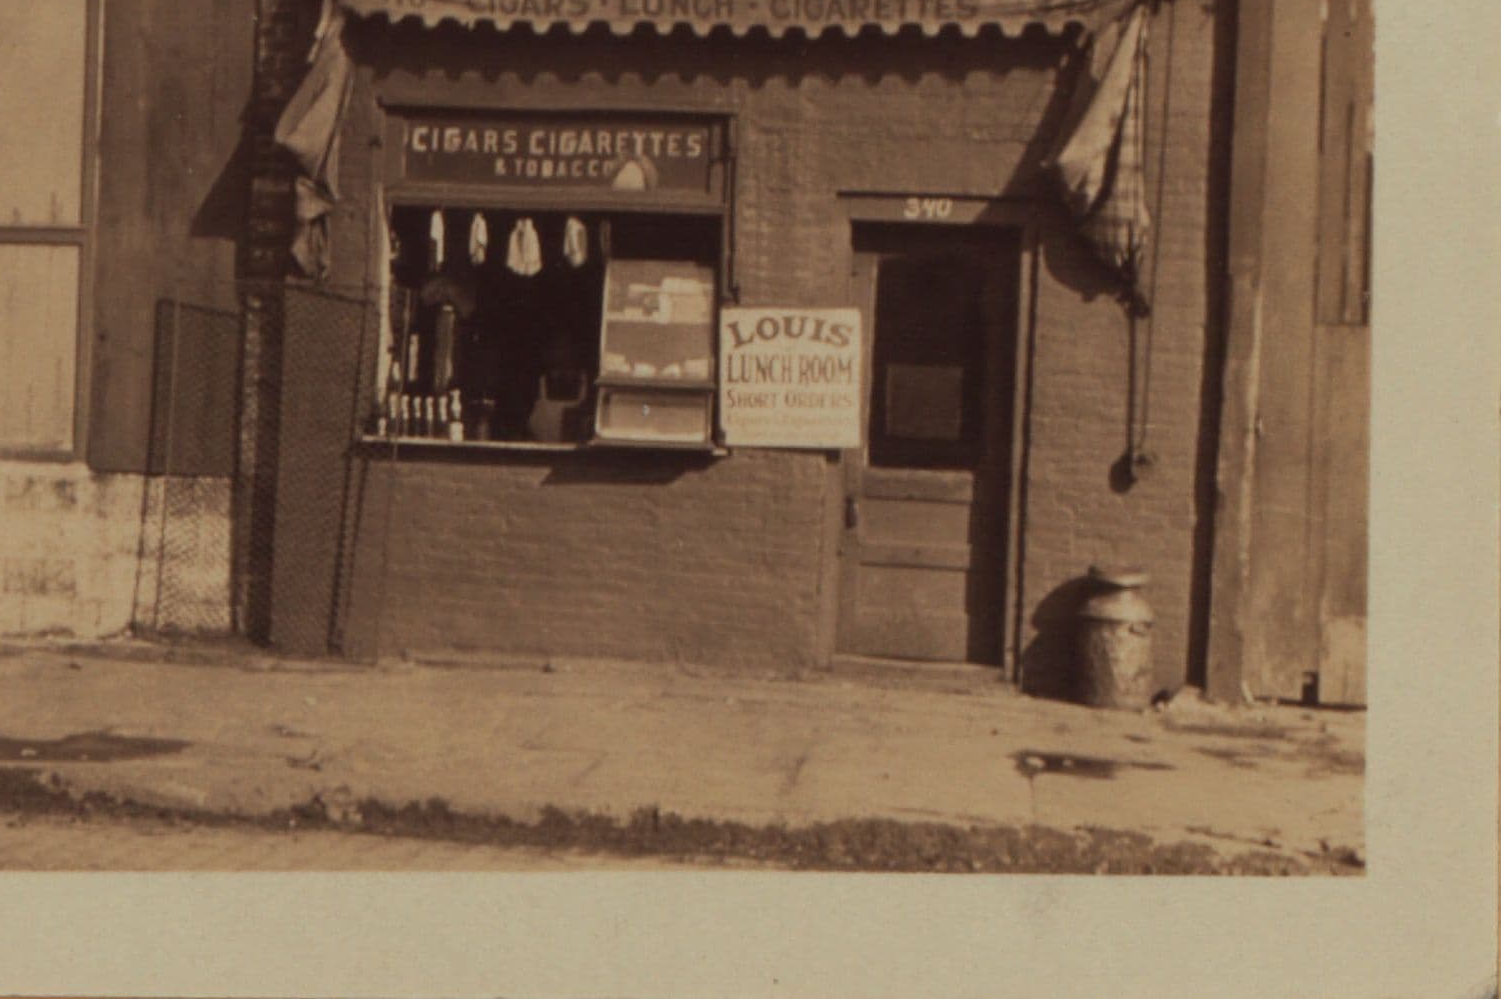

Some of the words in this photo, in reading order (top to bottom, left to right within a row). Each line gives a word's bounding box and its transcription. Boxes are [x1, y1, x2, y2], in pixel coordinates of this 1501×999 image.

[410, 126, 518, 154] CIGARS
[529, 129, 702, 158] CIGARETTES
[903, 197, 953, 219] 340
[726, 315, 854, 349] LOUIS
[726, 353, 792, 385] LUNCH
[798, 353, 853, 386] ROOM
